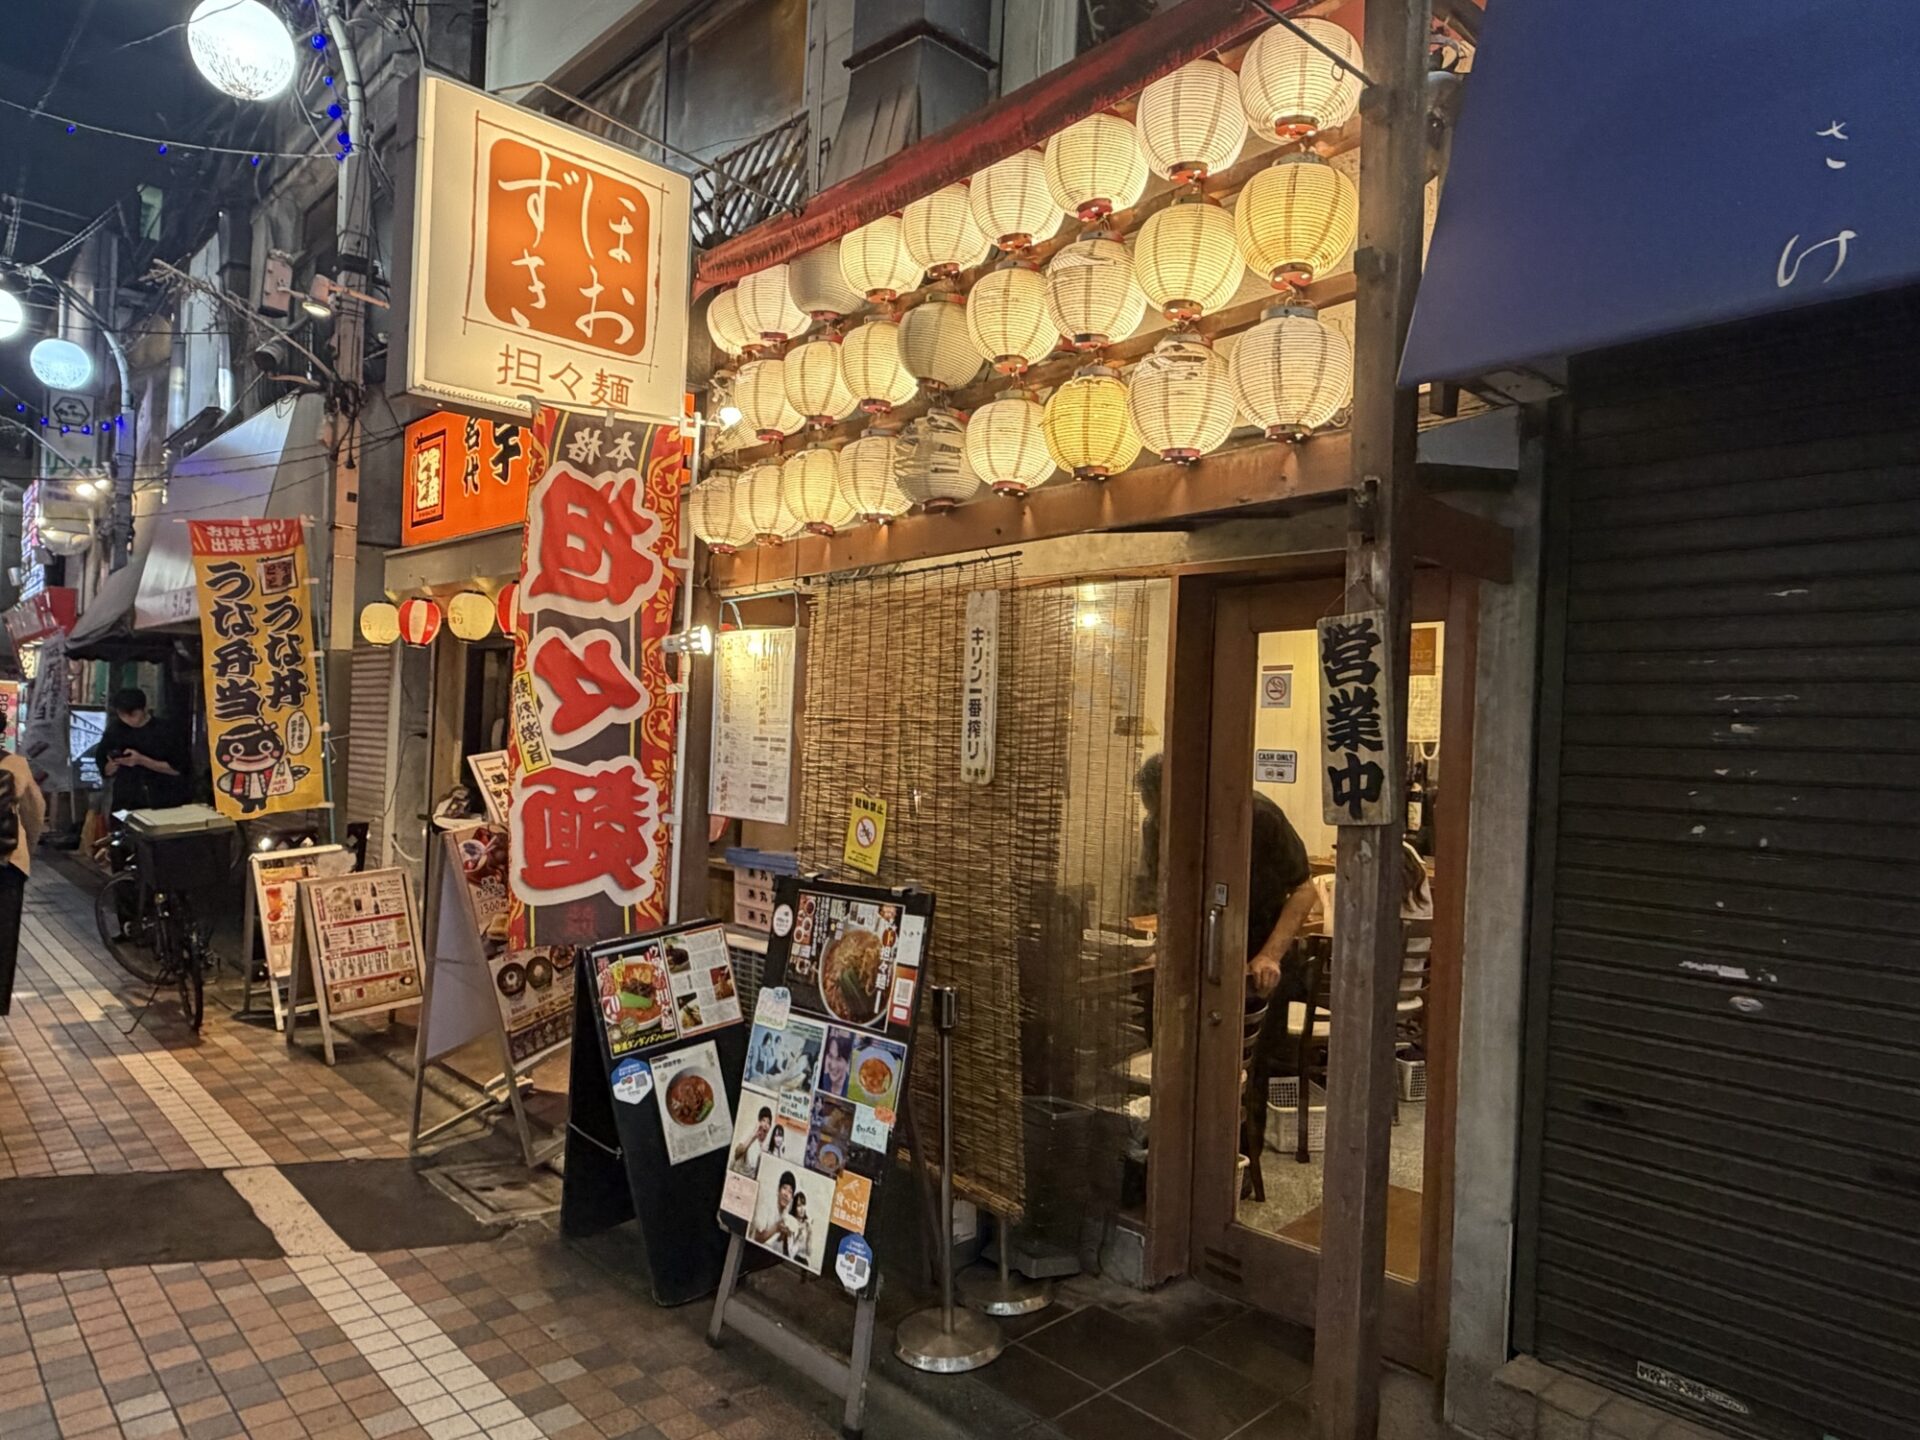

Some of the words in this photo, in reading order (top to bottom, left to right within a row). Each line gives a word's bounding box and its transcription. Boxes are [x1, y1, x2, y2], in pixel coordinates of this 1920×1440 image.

[1777, 120, 1857, 288] さけ
[496, 343, 634, 407] 担々麺
[206, 560, 264, 721] うな弁当
[262, 595, 310, 711] うな丼
[967, 628, 984, 760] キリン一番搾り
[1276, 753, 1293, 761] ONLY
[1321, 618, 1385, 821] 営業中
